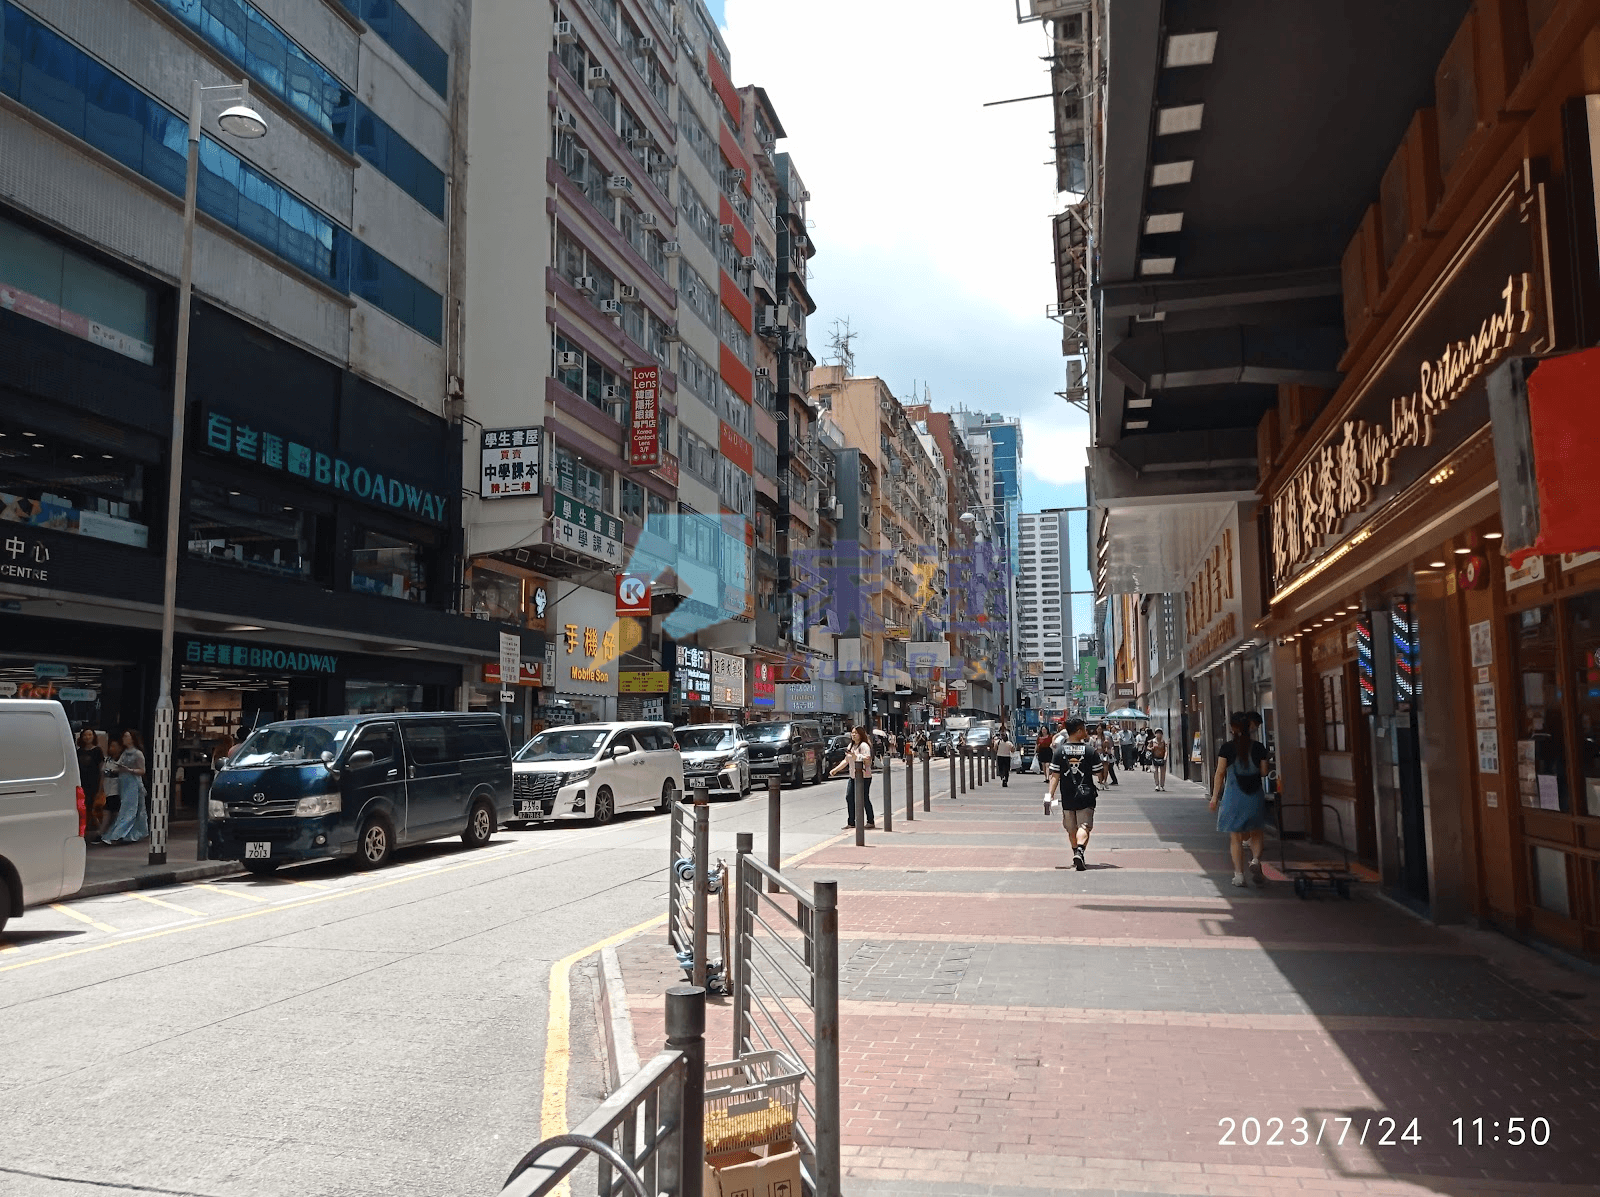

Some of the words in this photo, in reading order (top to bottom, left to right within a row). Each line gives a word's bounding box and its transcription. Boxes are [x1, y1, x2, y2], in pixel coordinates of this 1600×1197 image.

[1421, 274, 1515, 414] Restaurant
[633, 371, 656, 380] Love
[633, 380, 657, 389] Lens
[485, 429, 538, 448] 學生書屋
[207, 411, 284, 470] 百老匯
[315, 452, 446, 522] BROADWAY
[484, 461, 538, 481] 中學課本
[5, 536, 50, 563] 中心
[1, 564, 48, 581] CENTRE
[565, 623, 616, 661] 手機仔
[250, 647, 339, 673] BROADWAY
[571, 666, 595, 681] Mobile
[596, 669, 609, 682] Son
[249, 850, 267, 858] 7013
[253, 842, 264, 850] VH
